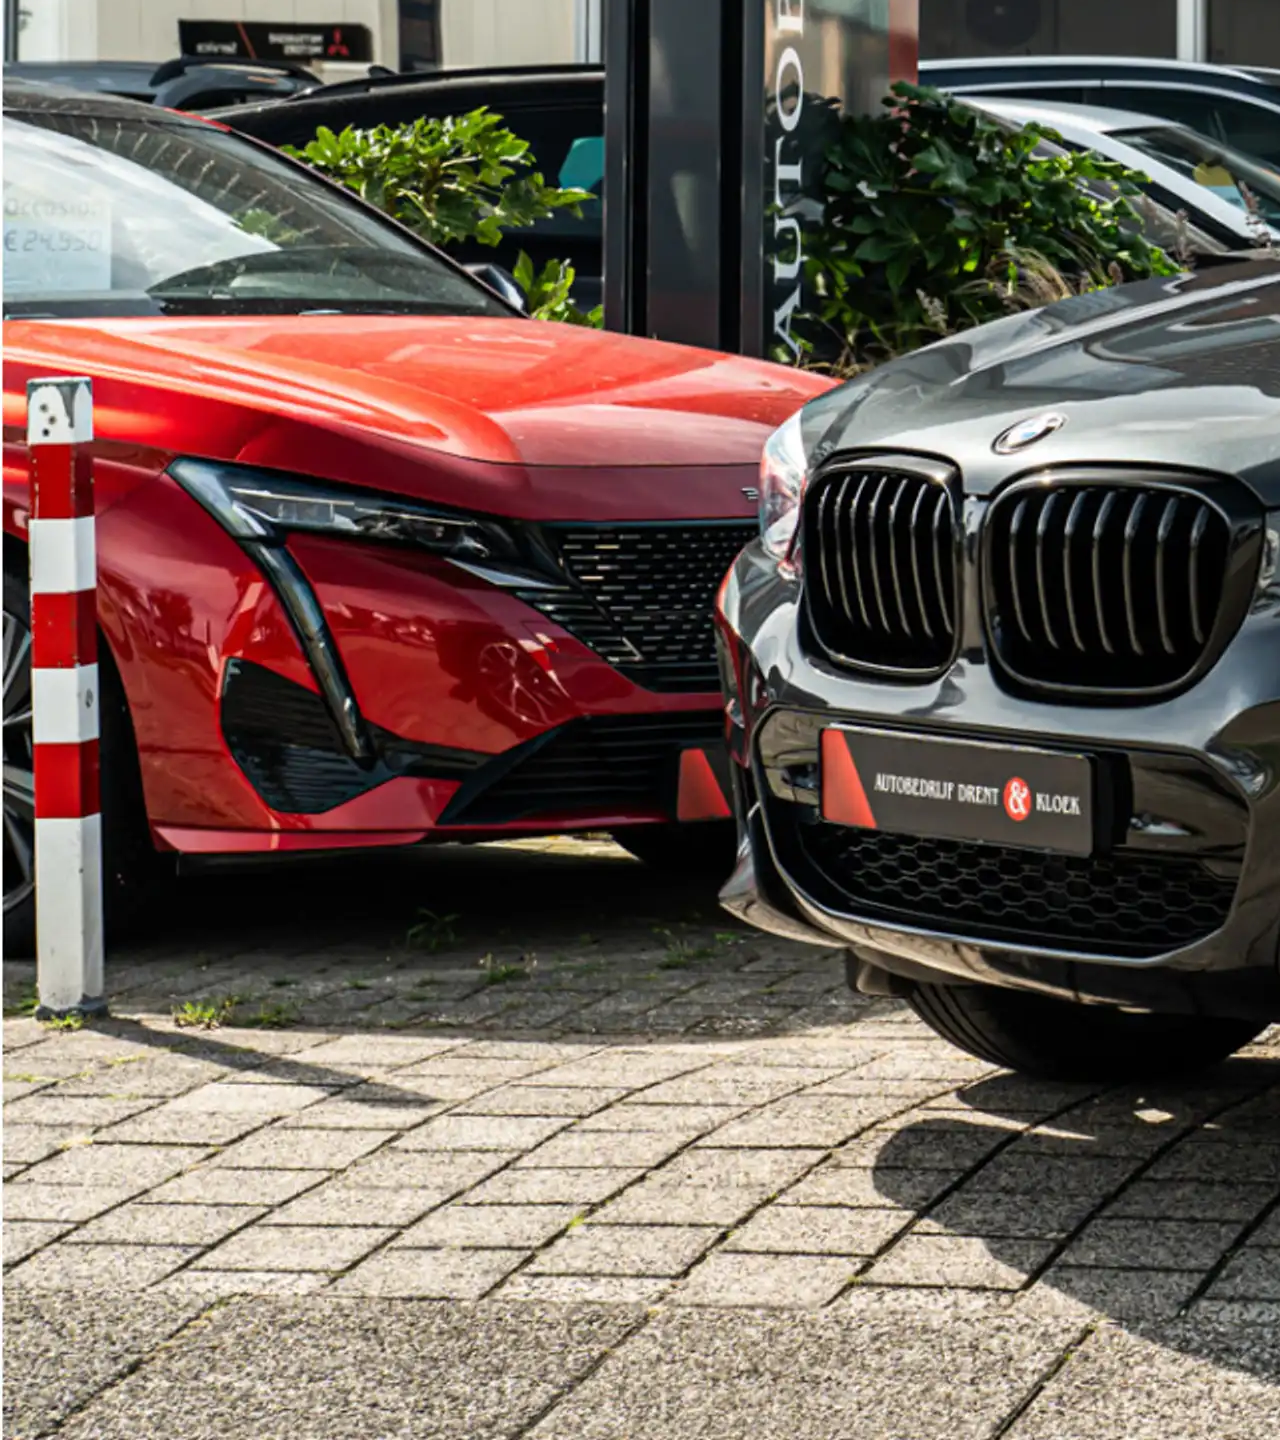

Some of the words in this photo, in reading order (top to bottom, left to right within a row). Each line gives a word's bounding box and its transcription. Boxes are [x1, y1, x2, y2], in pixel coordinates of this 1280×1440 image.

[874, 772, 954, 801] AUTOBEDRIJF
[957, 783, 1000, 806] DRENT
[1008, 781, 1028, 814] &
[1035, 791, 1081, 816] KLOEK
